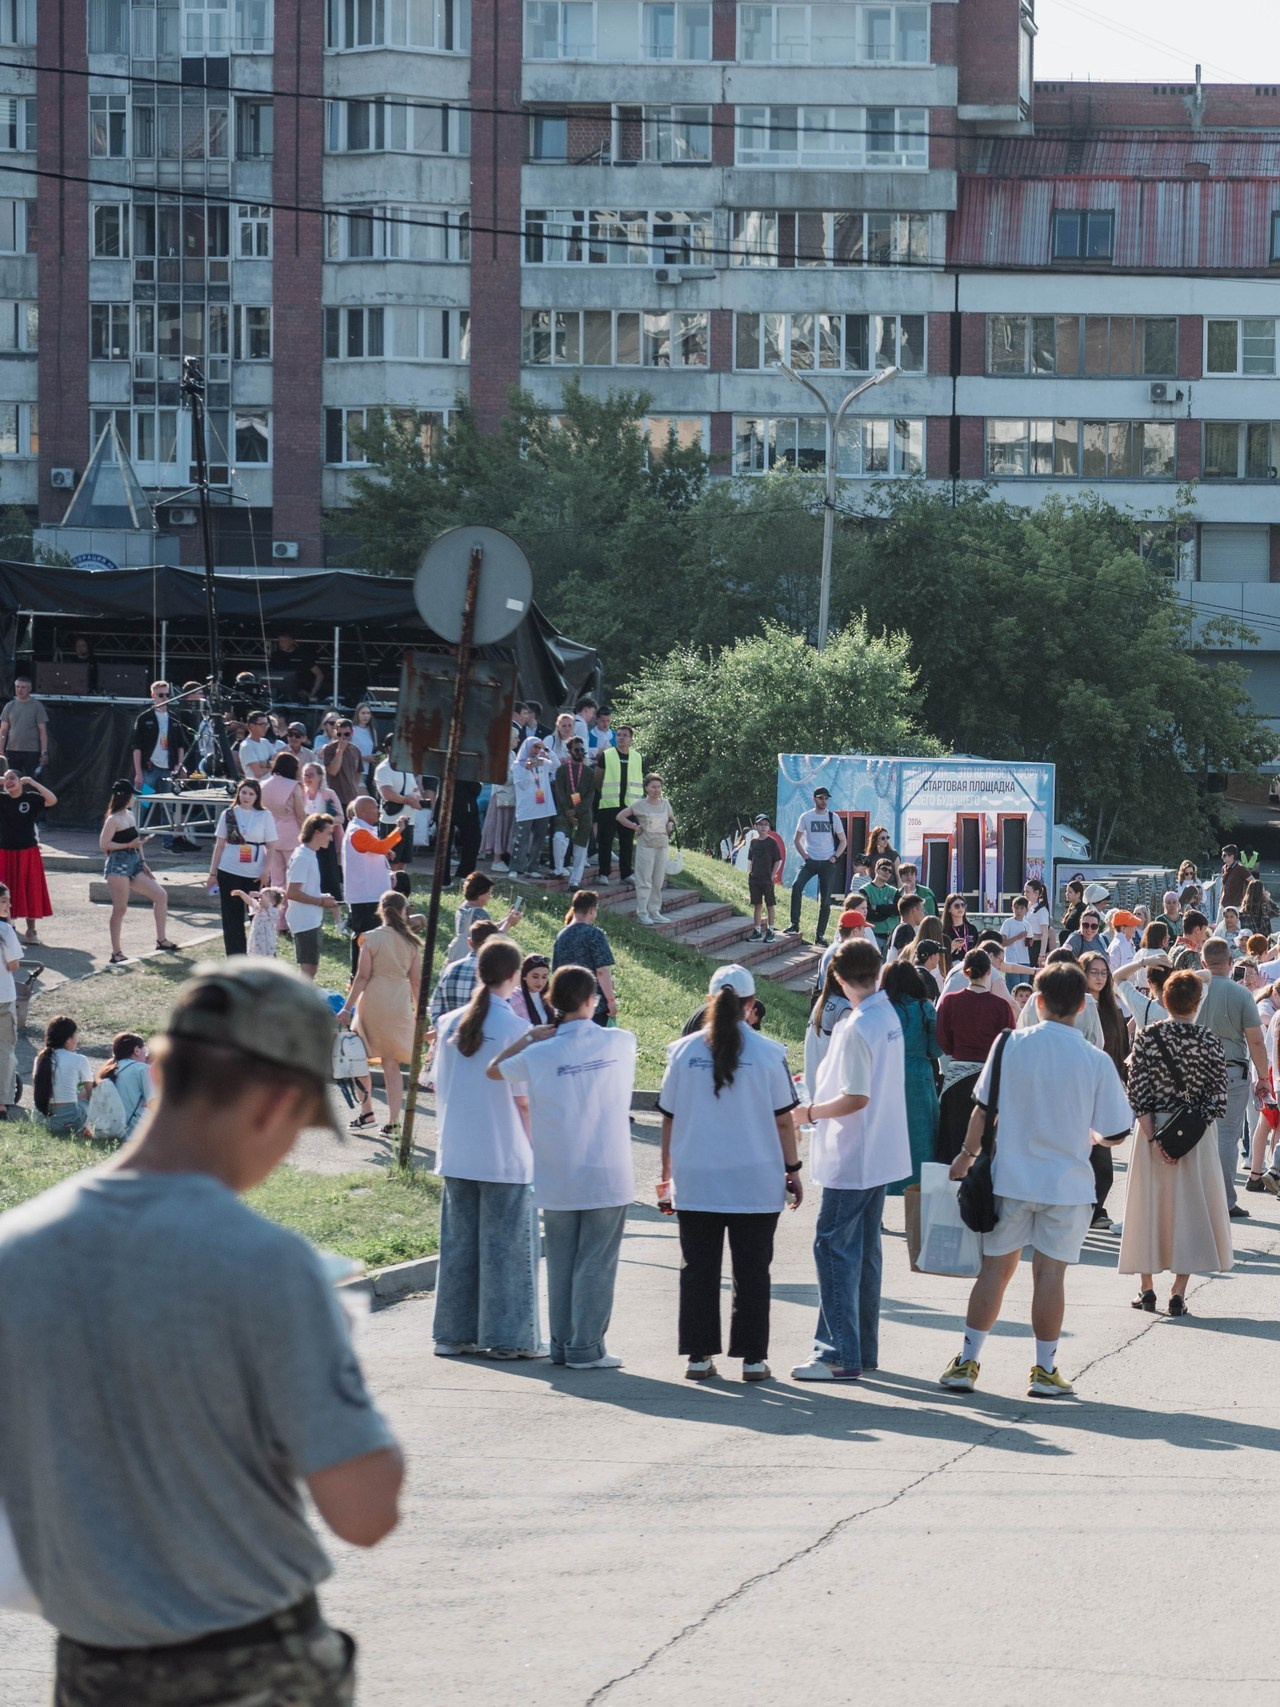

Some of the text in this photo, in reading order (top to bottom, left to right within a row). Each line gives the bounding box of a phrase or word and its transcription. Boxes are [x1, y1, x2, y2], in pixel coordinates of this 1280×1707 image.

[923, 780, 967, 792] СТАРТОВАЯ
[969, 781, 1016, 794] ПЛОЩАДКА
[937, 794, 981, 808] БУДУЩЕГО
[908, 817, 922, 826] 2006
